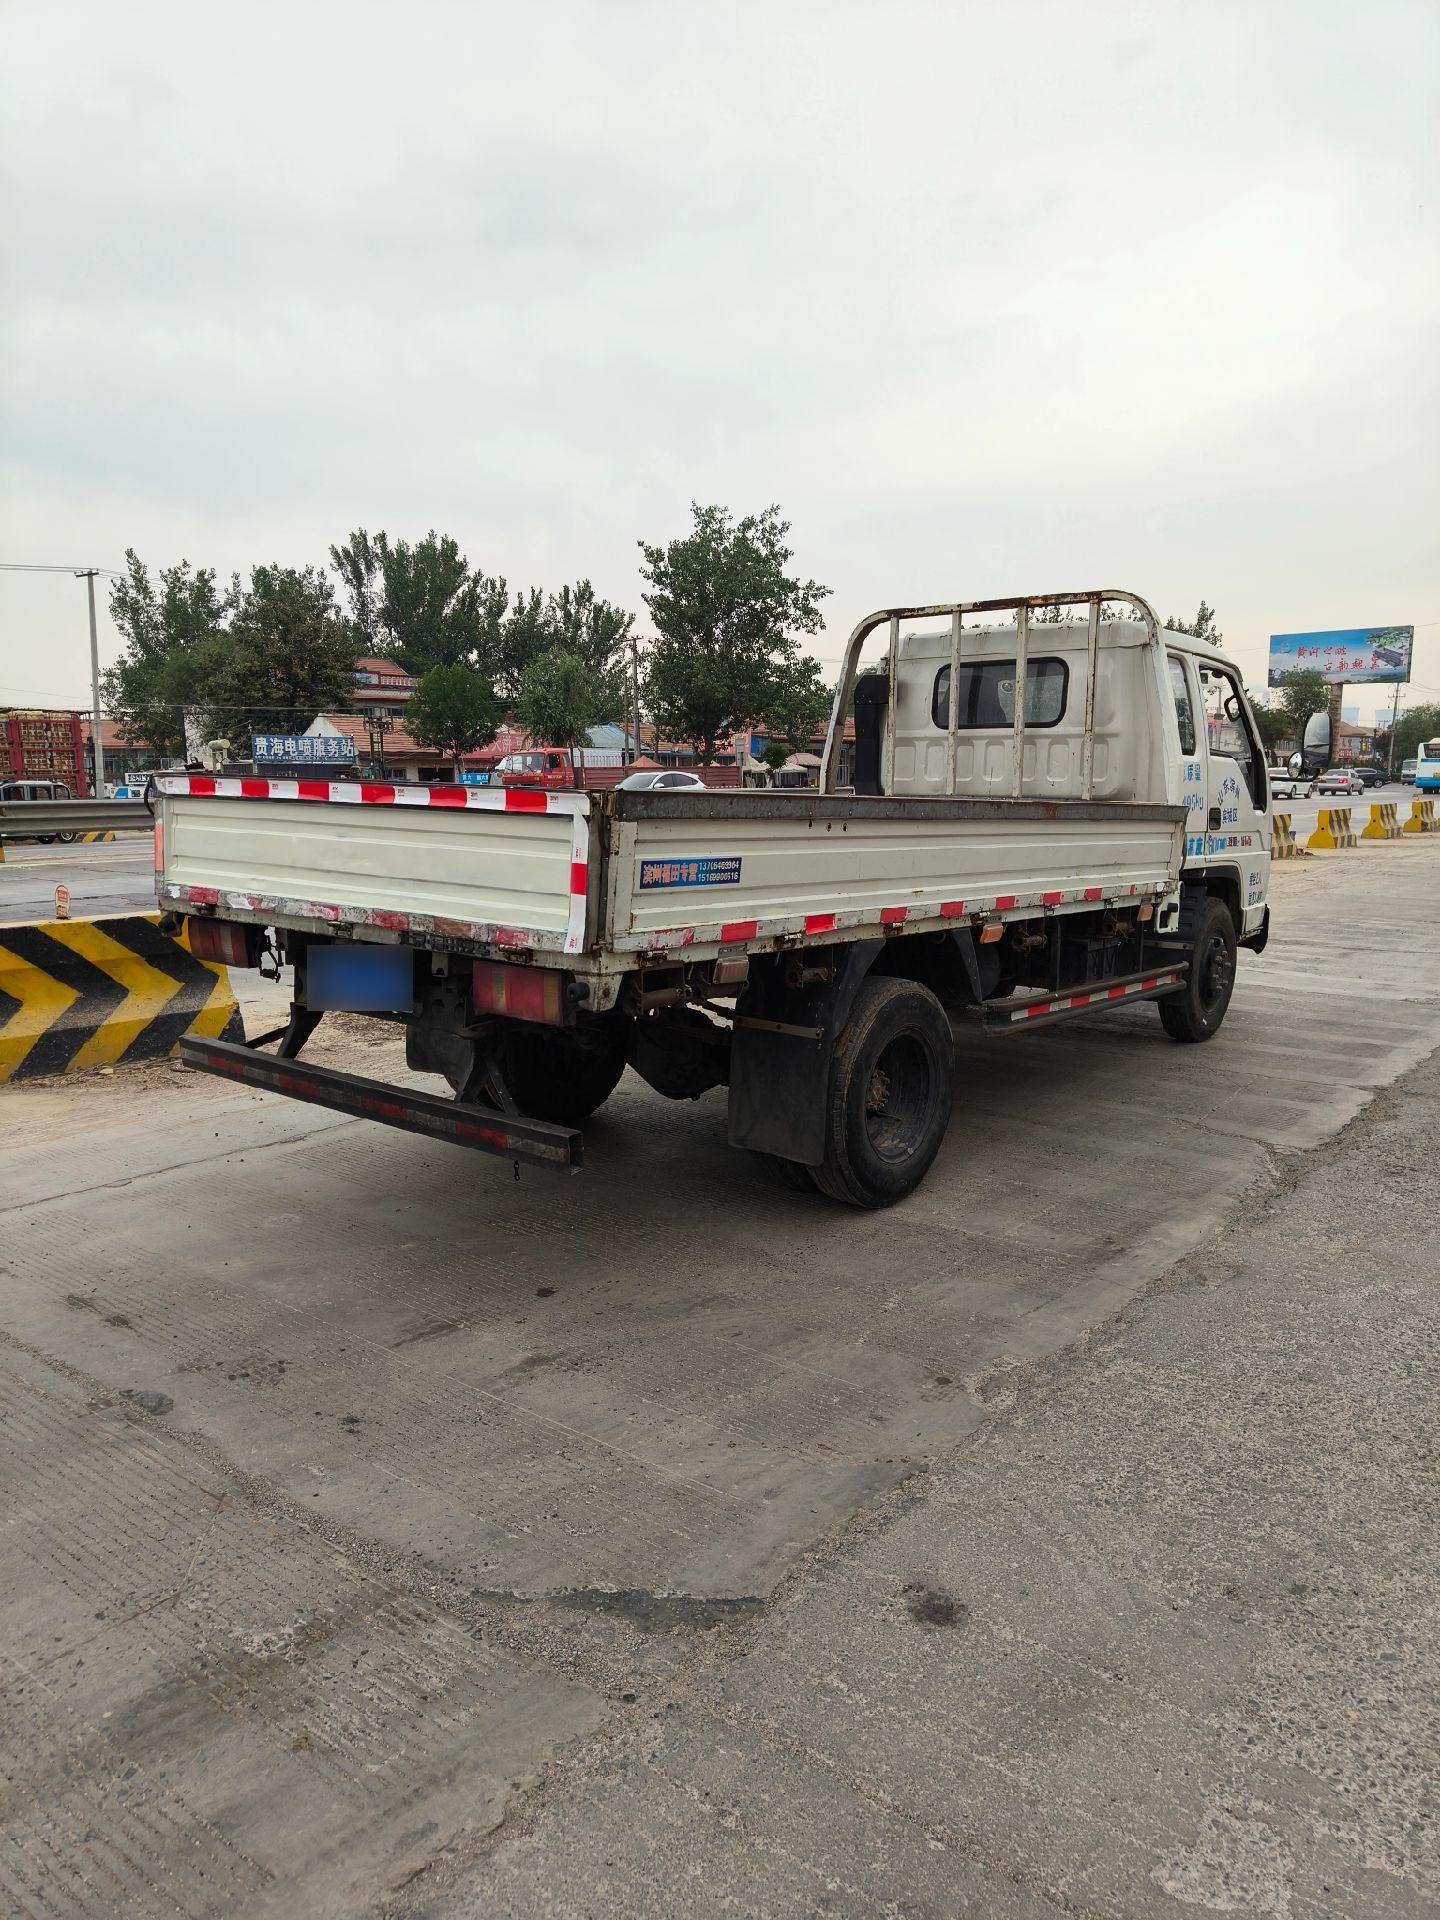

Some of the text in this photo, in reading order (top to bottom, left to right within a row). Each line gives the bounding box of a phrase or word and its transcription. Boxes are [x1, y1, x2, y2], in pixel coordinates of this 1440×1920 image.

[254, 737, 354, 757] 贵海电喷服务站
